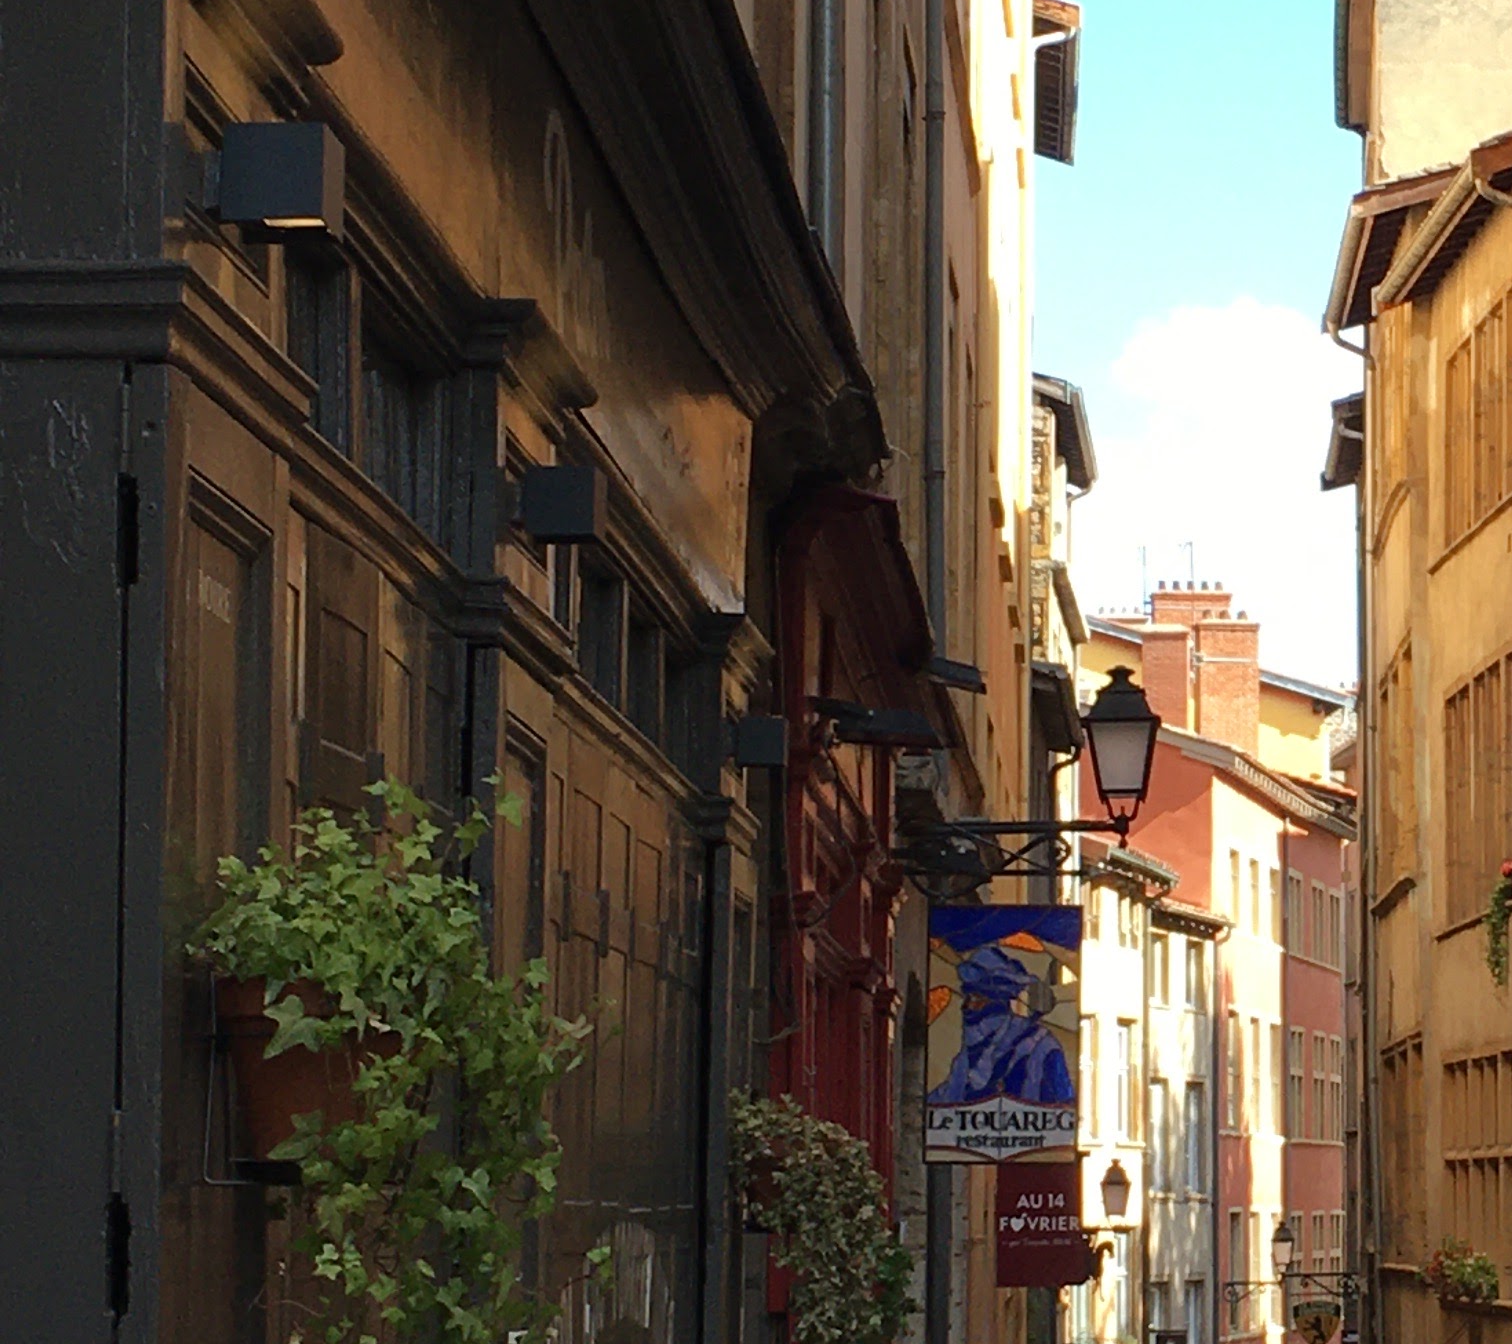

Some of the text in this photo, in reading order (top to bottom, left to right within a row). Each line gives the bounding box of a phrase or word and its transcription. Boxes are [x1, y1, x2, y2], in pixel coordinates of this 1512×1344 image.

[928, 1109, 1076, 1132] Le TOUAREG
[955, 1132, 1047, 1149] restaurant
[1016, 1193, 1066, 1209] AU 14
